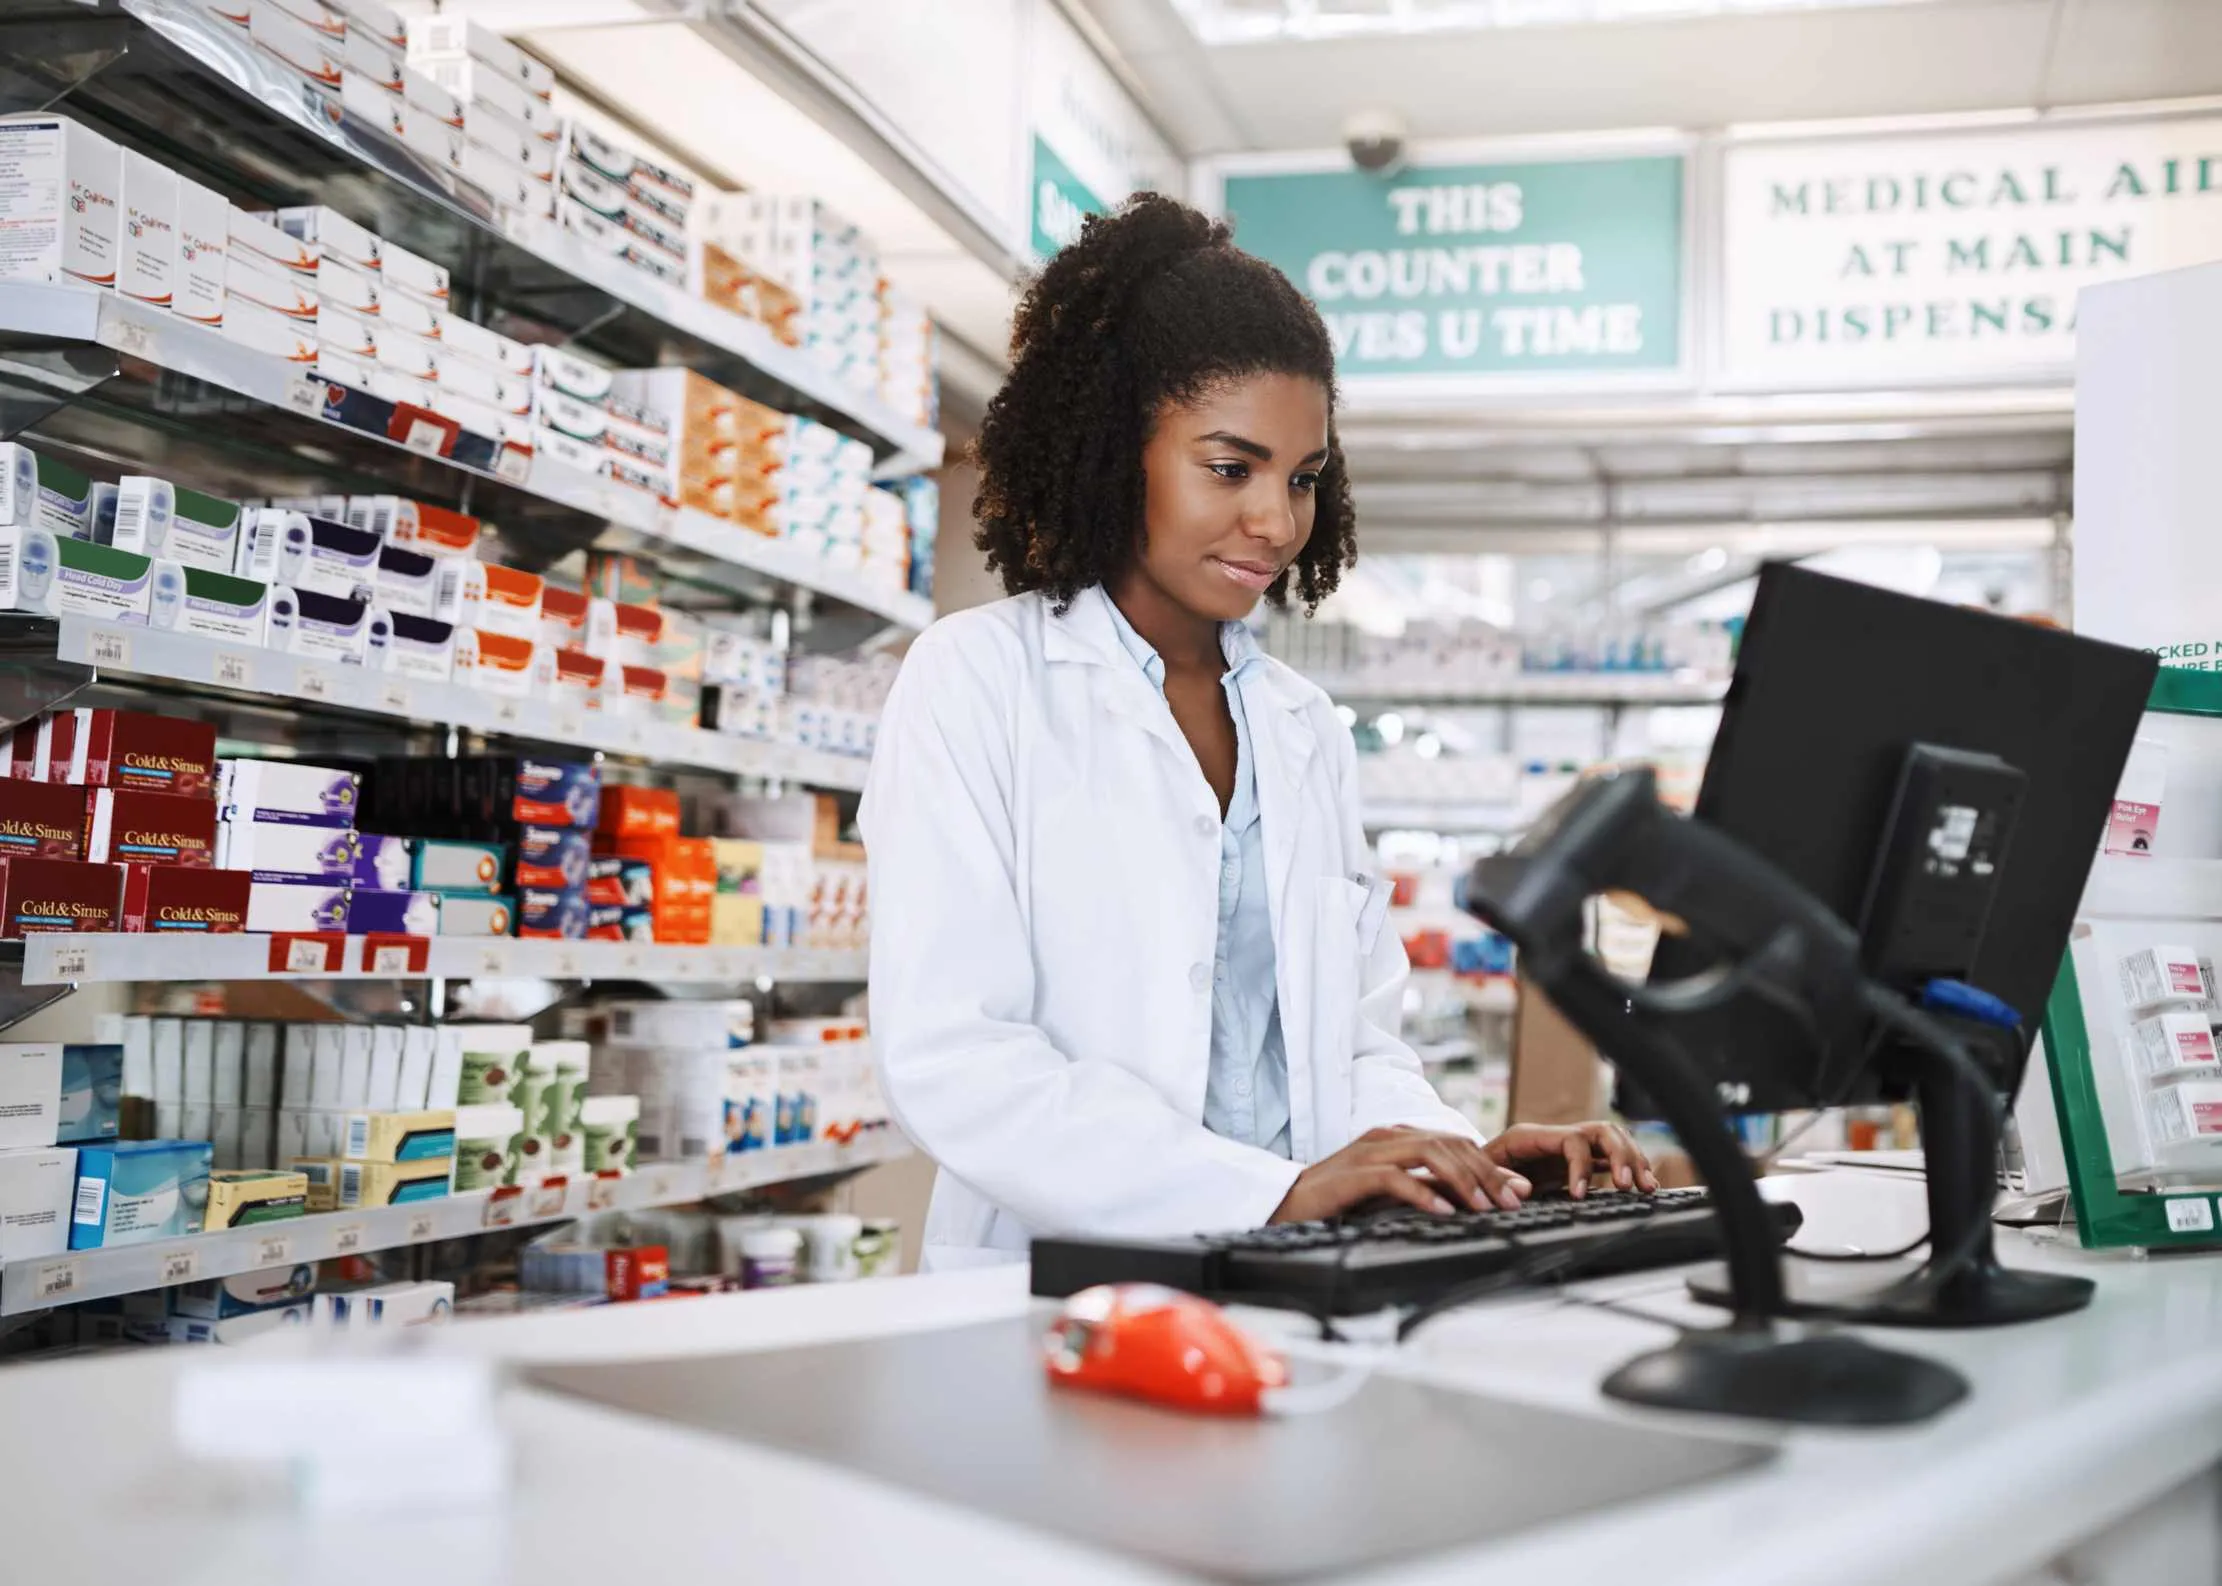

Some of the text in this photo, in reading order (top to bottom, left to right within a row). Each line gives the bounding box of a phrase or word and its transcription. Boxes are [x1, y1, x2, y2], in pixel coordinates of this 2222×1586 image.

[1387, 181, 1523, 235] THIS
[1767, 165, 2077, 217] MEDICAL
[1309, 241, 1585, 300] COUNTER
[1840, 224, 2134, 279] AT MAIN
[1328, 303, 1642, 361] VES U TIME
[1768, 295, 2076, 344] DISPENS
[125, 752, 156, 769] Cold
[170, 757, 205, 774] Sinus
[0, 820, 19, 834] old
[35, 823, 73, 841] Sinus
[124, 830, 157, 846] Cold
[171, 833, 206, 849] Sinus
[21, 899, 55, 916] Cold
[71, 903, 110, 919] Sinus
[160, 906, 191, 920] Cold
[205, 907, 240, 922] Sinus
